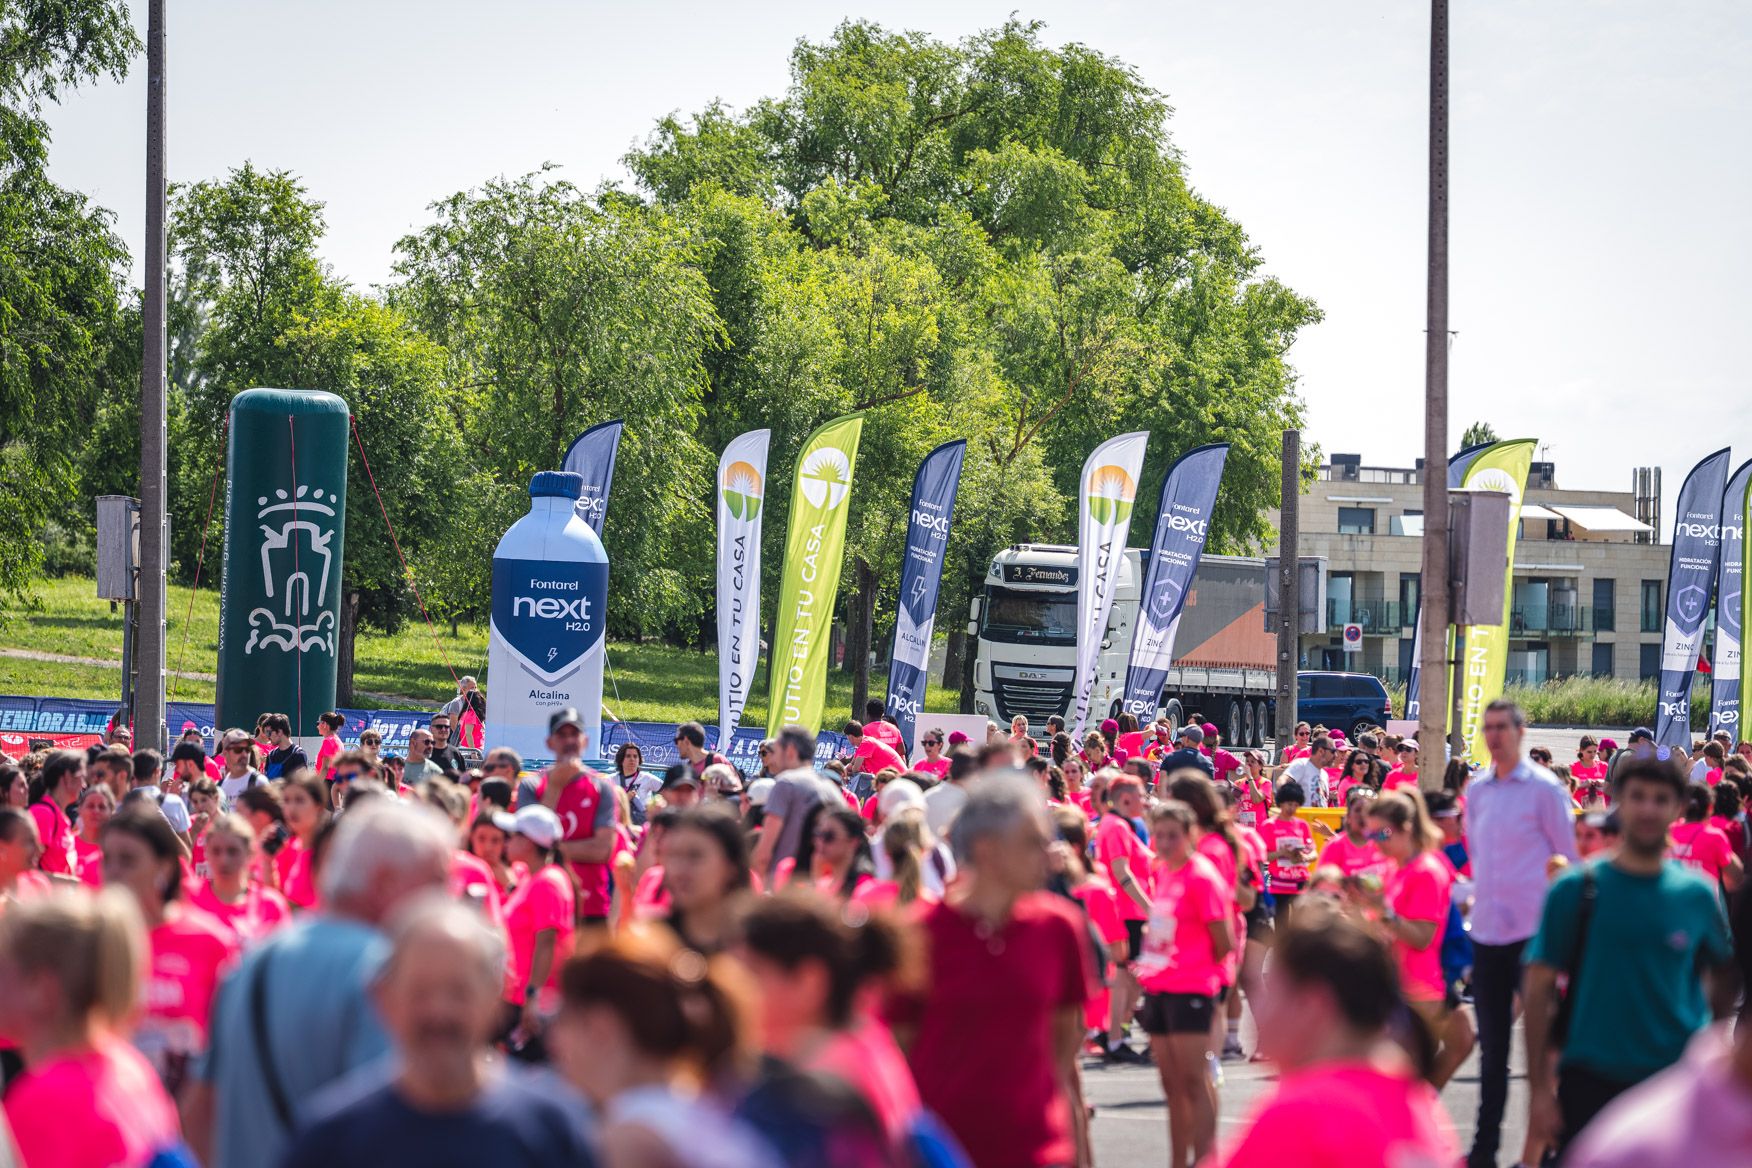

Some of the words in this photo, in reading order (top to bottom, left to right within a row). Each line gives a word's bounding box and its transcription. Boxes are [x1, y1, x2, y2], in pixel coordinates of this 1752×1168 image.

[576, 496, 604, 511] ext
[912, 509, 949, 533] next
[1160, 513, 1207, 535] next
[1686, 512, 1714, 520] Fontarel
[931, 531, 947, 540] H2.0
[1676, 522, 1720, 538] next
[1186, 534, 1204, 543] H2.0
[801, 524, 825, 583] CASA
[219, 480, 233, 650] www.vitoria-gasteiz.org
[733, 535, 746, 591] CASA
[1096, 541, 1112, 599] CASA
[1025, 567, 1069, 583] Fernandez
[530, 578, 579, 591] Fontarel
[513, 595, 591, 620] next
[732, 598, 742, 625] TU
[796, 590, 814, 621] TU
[566, 621, 591, 632] H2.0
[1472, 626, 1489, 640] T
[793, 628, 809, 659] EN
[901, 632, 926, 647] ALCALIN
[1146, 638, 1163, 648] ZINC
[731, 635, 741, 665] EN
[1469, 647, 1488, 677] EN
[1019, 671, 1047, 679] DAF
[528, 689, 570, 700] Alcalina
[904, 714, 916, 723] H2.
